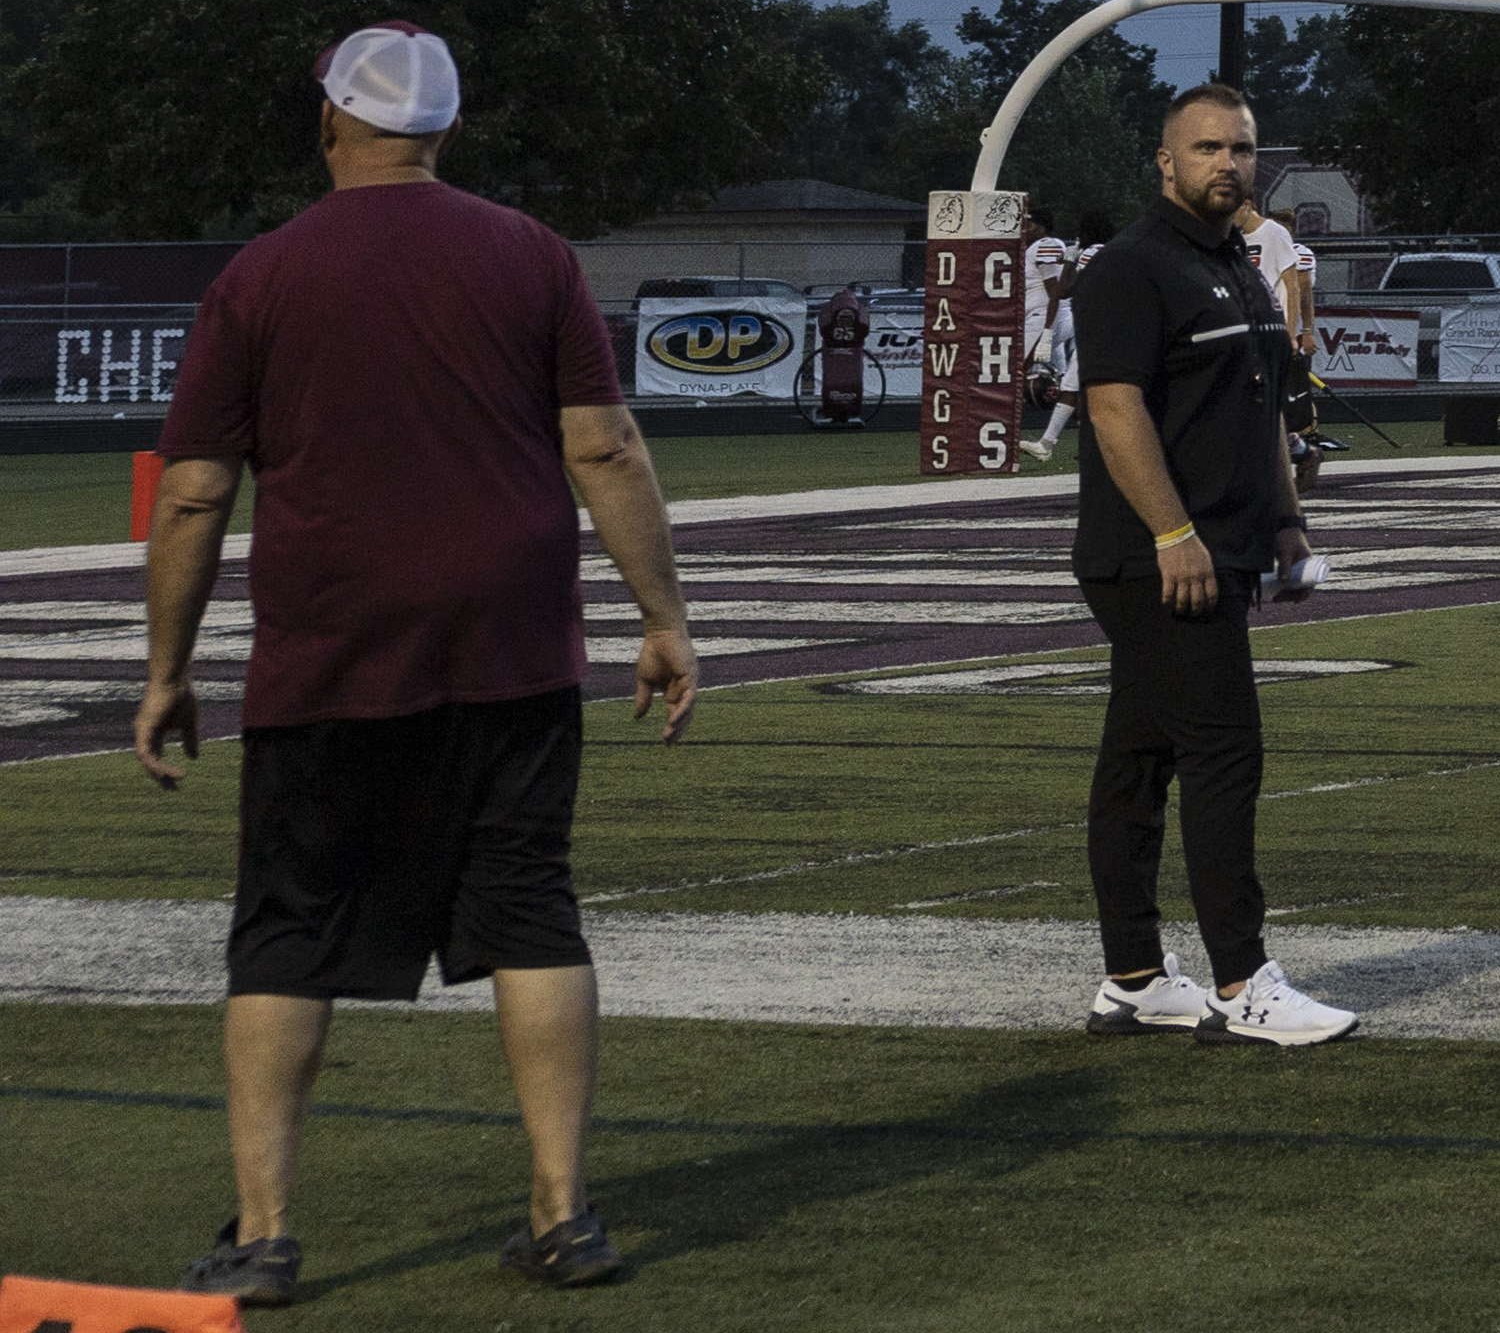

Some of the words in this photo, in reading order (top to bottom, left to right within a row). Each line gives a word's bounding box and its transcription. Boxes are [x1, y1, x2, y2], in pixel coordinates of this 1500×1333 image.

[686, 314, 764, 361] DP
[927, 251, 960, 470] DAWGS
[978, 251, 1014, 470] GHS
[1445, 328, 1476, 338] Grand
